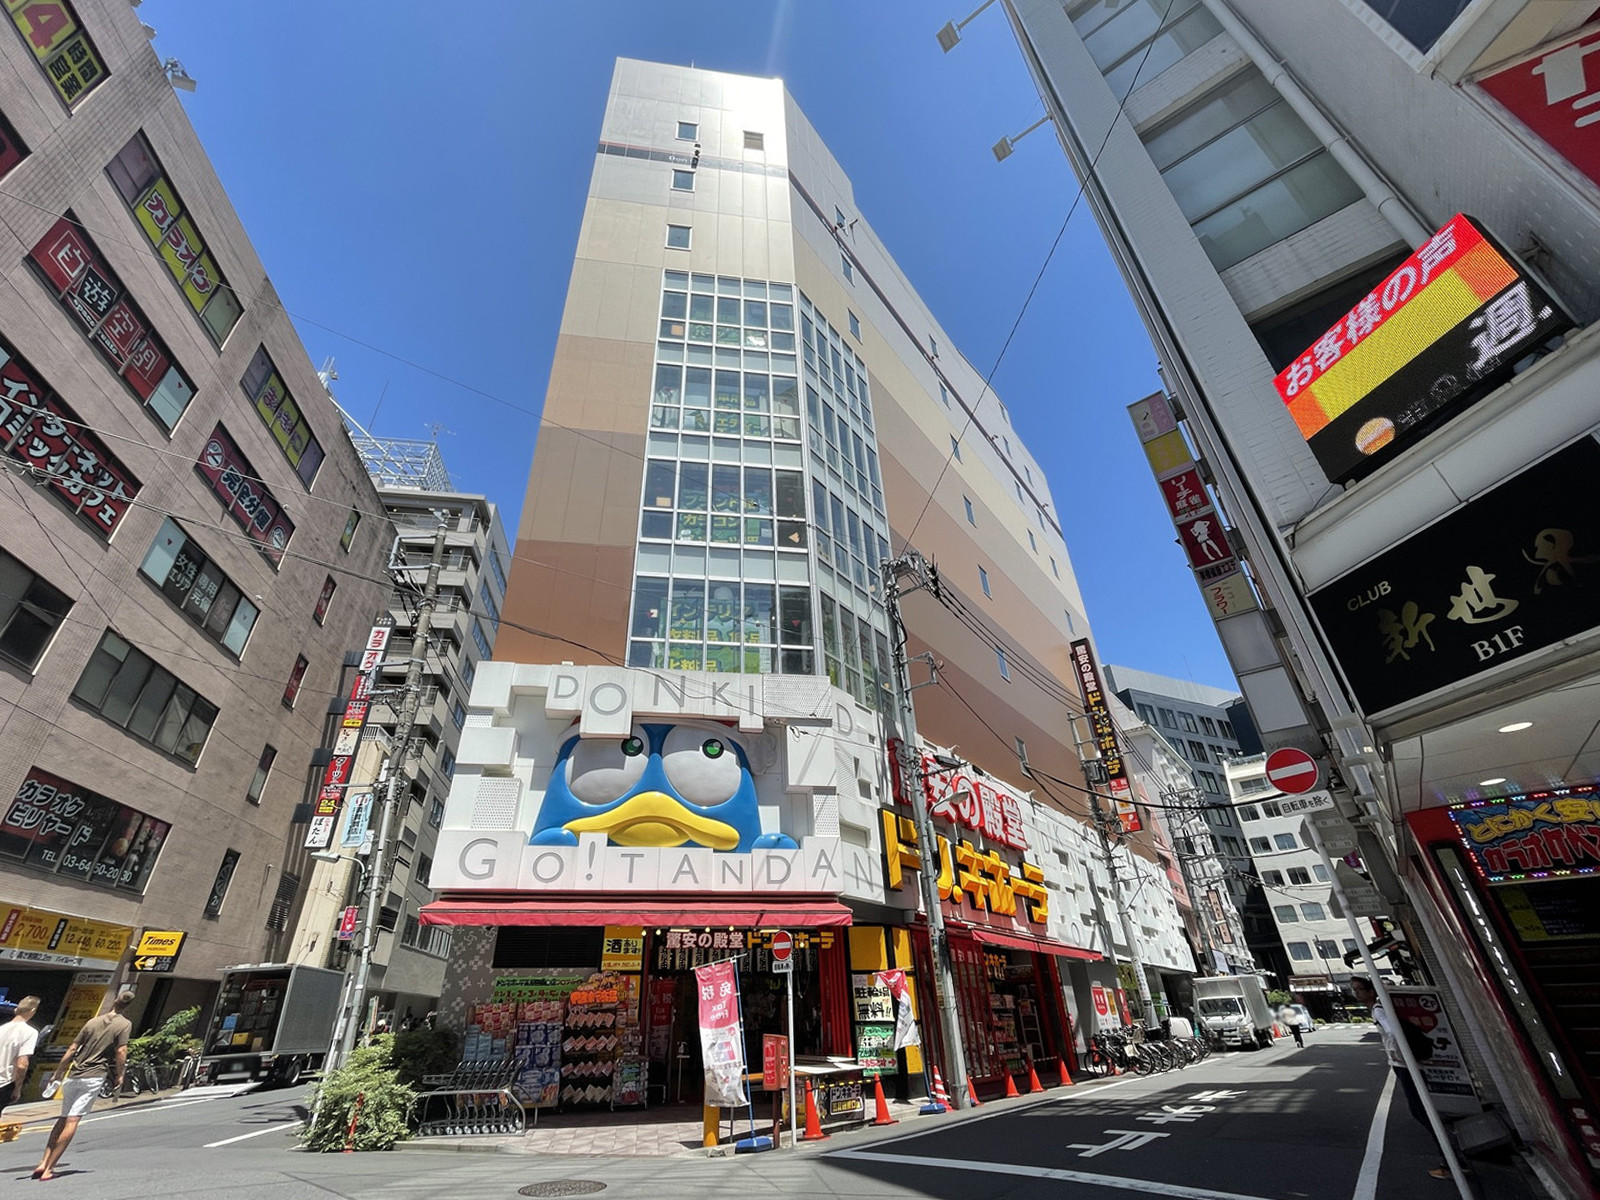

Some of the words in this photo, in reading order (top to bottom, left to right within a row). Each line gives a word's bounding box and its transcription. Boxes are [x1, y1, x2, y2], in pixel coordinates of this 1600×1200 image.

[49, 54, 82, 100] 営業
[67, 40, 98, 83] 時間
[144, 190, 213, 293] カラオケ
[57, 243, 156, 371] 自遊空間
[1286, 224, 1456, 396] お客様の声
[3, 378, 129, 503] インターネット
[176, 553, 218, 599] 女性専用
[1347, 581, 1391, 611] CLUB
[1471, 626, 1525, 662] B1F
[553, 675, 755, 716] DONKI
[17, 779, 85, 817] カラオケ
[1281, 795, 1330, 813] 自転車を除く
[144, 936, 176, 946] Times
[606, 938, 623, 953] 酒
[666, 932, 743, 948] 驚安の殿堂
